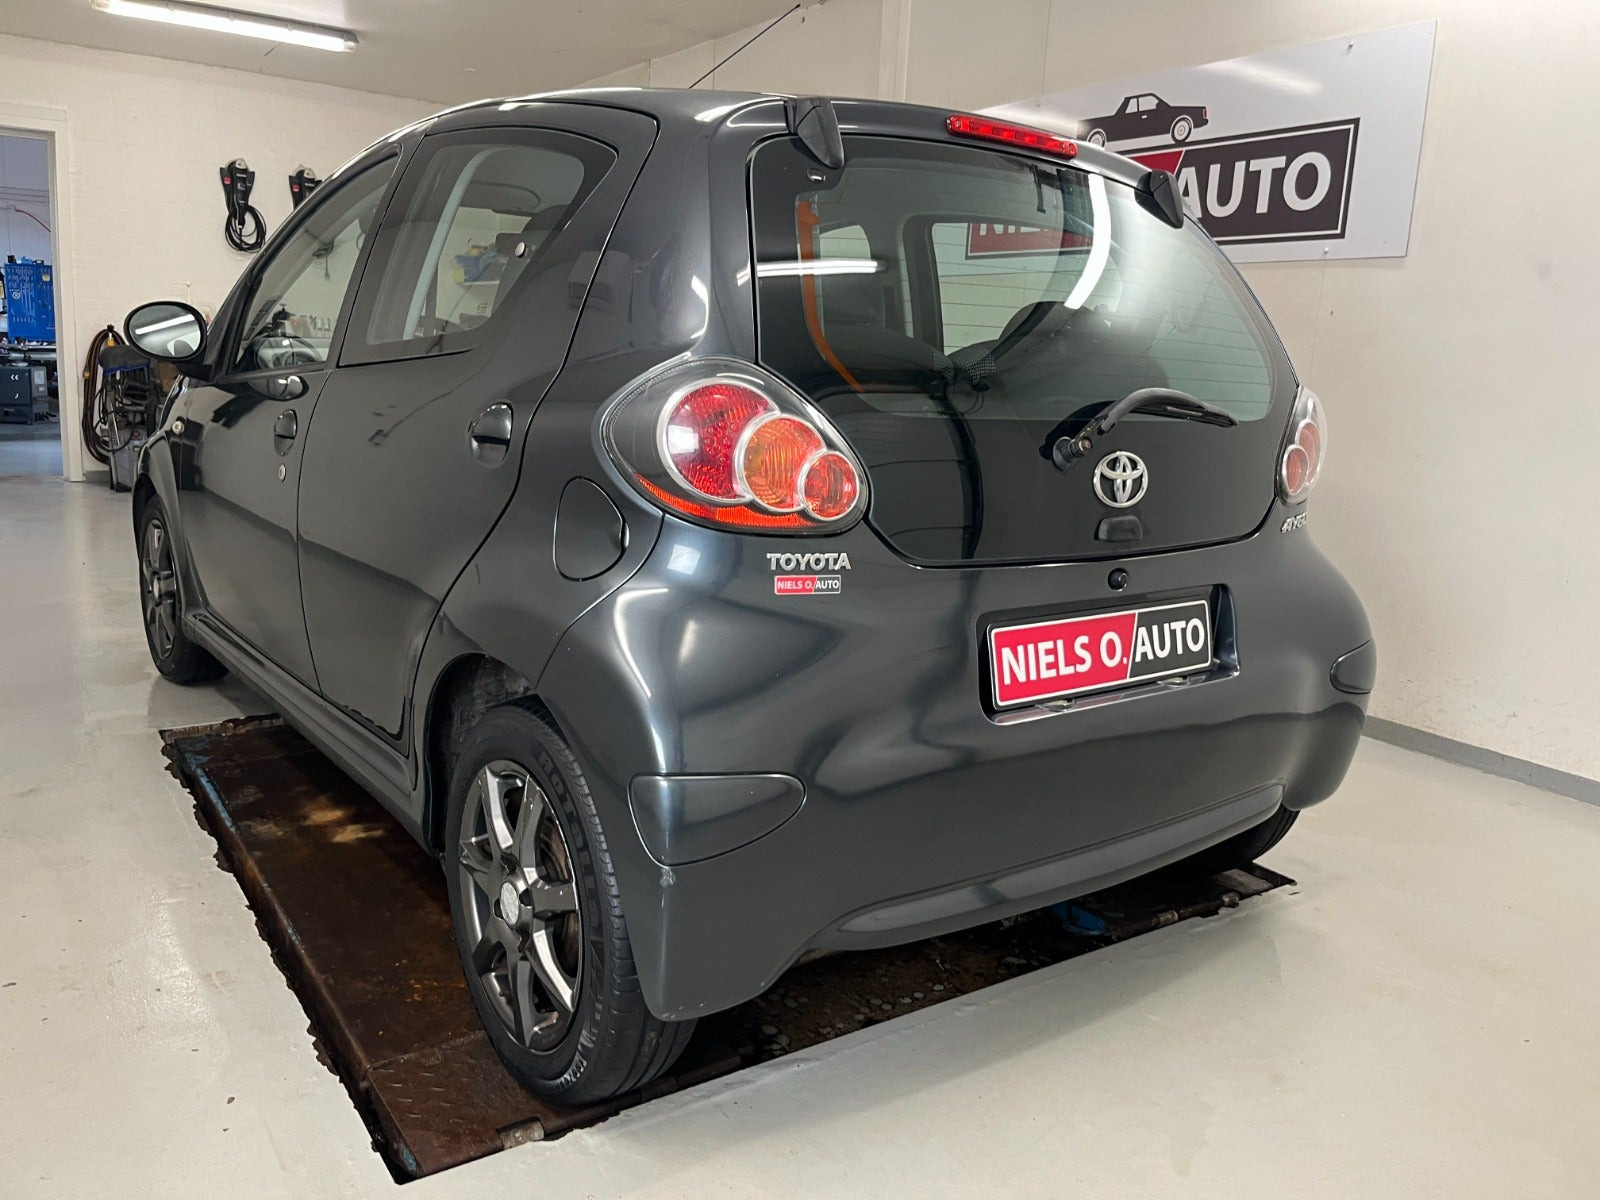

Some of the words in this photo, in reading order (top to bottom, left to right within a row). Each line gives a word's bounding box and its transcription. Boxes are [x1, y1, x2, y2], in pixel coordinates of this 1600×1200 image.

[1177, 151, 1332, 219] AUTO
[766, 552, 852, 571] TOYOTA
[777, 580, 803, 590] NIELS
[815, 580, 839, 589] AUTO
[1001, 635, 1093, 685] NIELS
[1099, 631, 1128, 668] O.
[1134, 618, 1205, 663] AUTO
